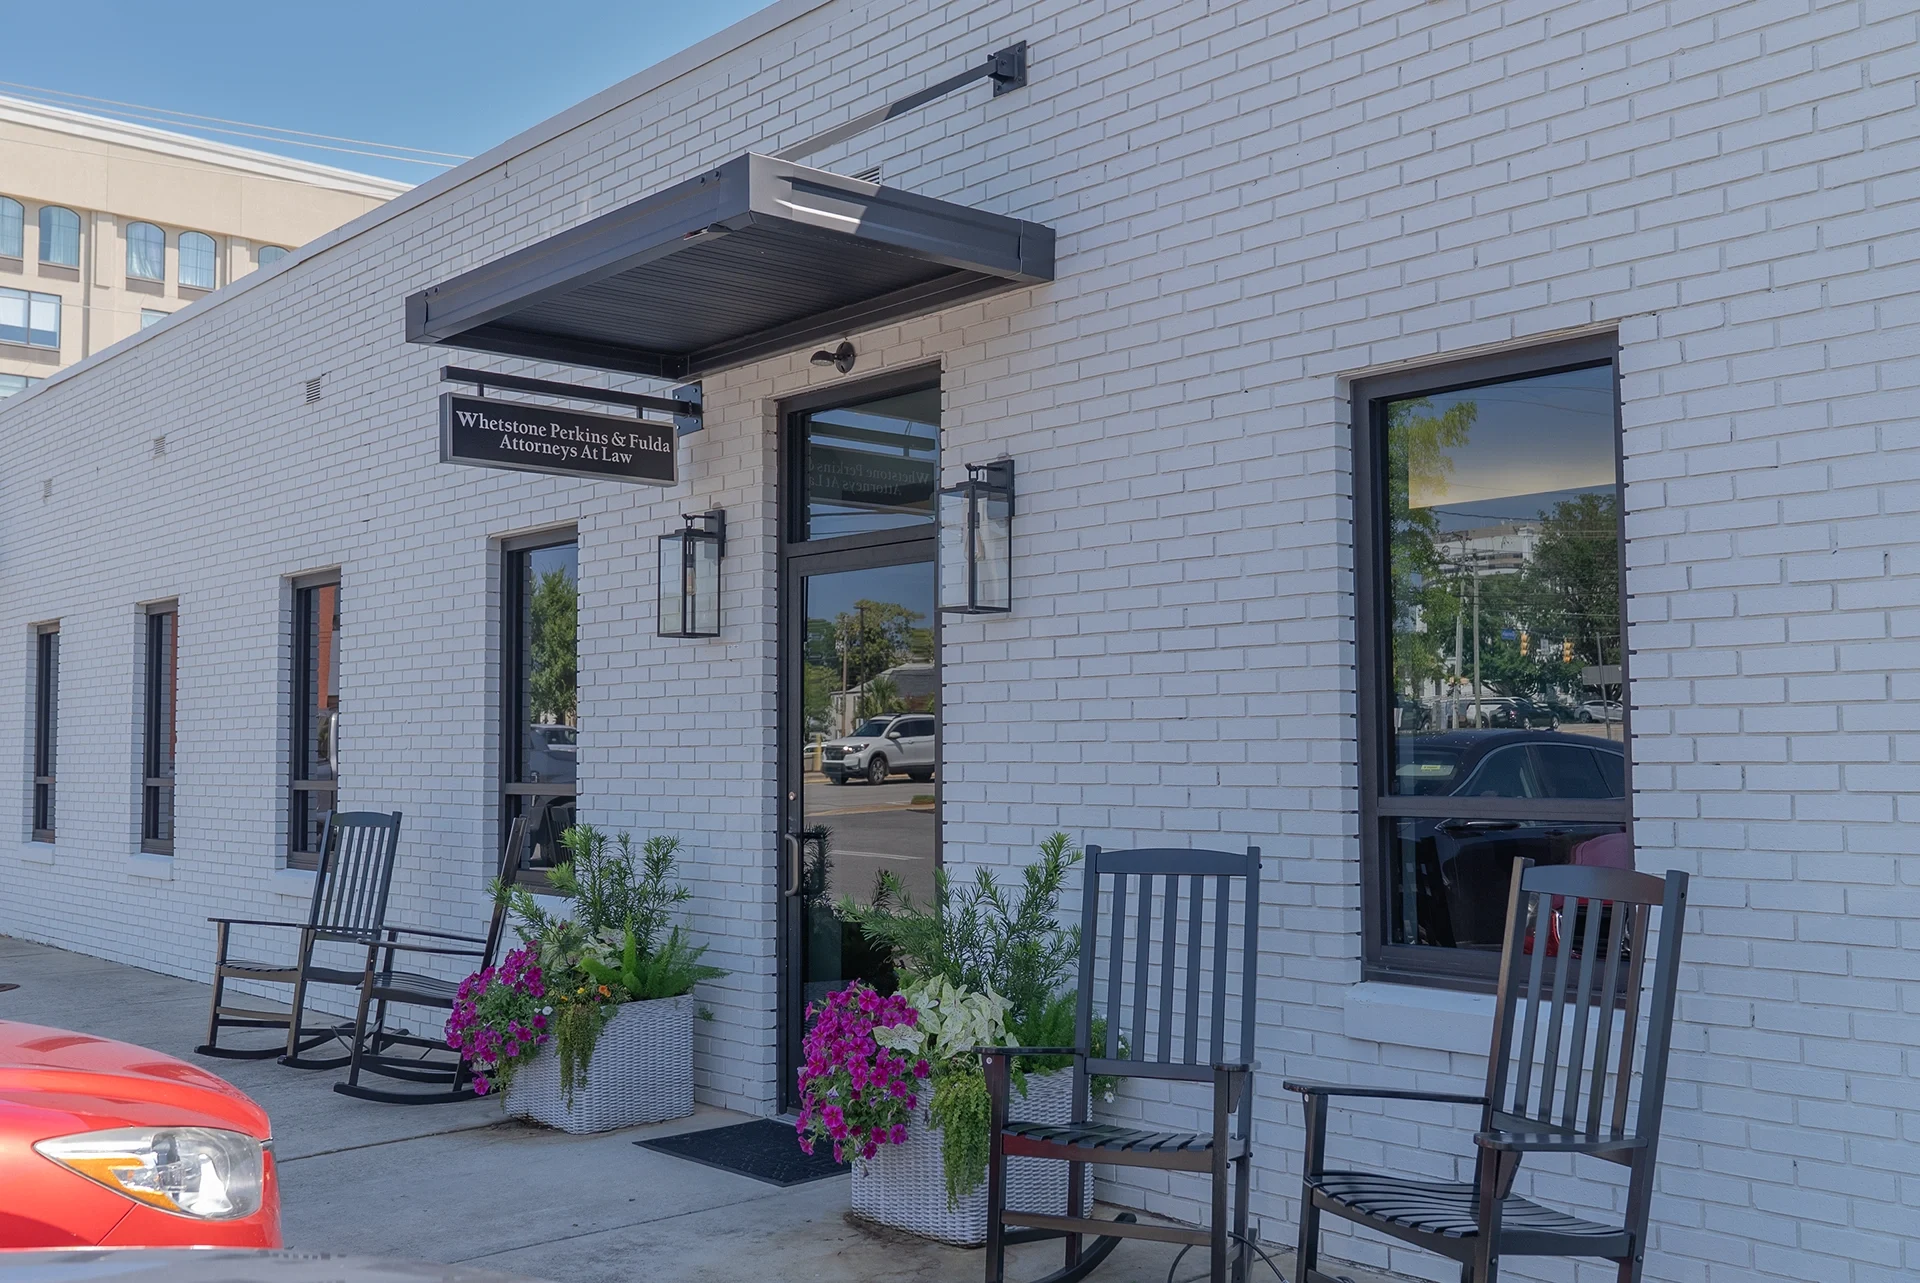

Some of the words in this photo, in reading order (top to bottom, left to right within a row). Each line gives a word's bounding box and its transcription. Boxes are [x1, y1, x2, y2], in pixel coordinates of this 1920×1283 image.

[456, 410, 547, 437] Whetstone
[550, 423, 608, 445] Perkins
[611, 431, 627, 447] &
[629, 433, 670, 453] Fulda
[499, 434, 577, 460] Attorneys
[580, 446, 599, 460] At
[602, 447, 633, 464] Law
